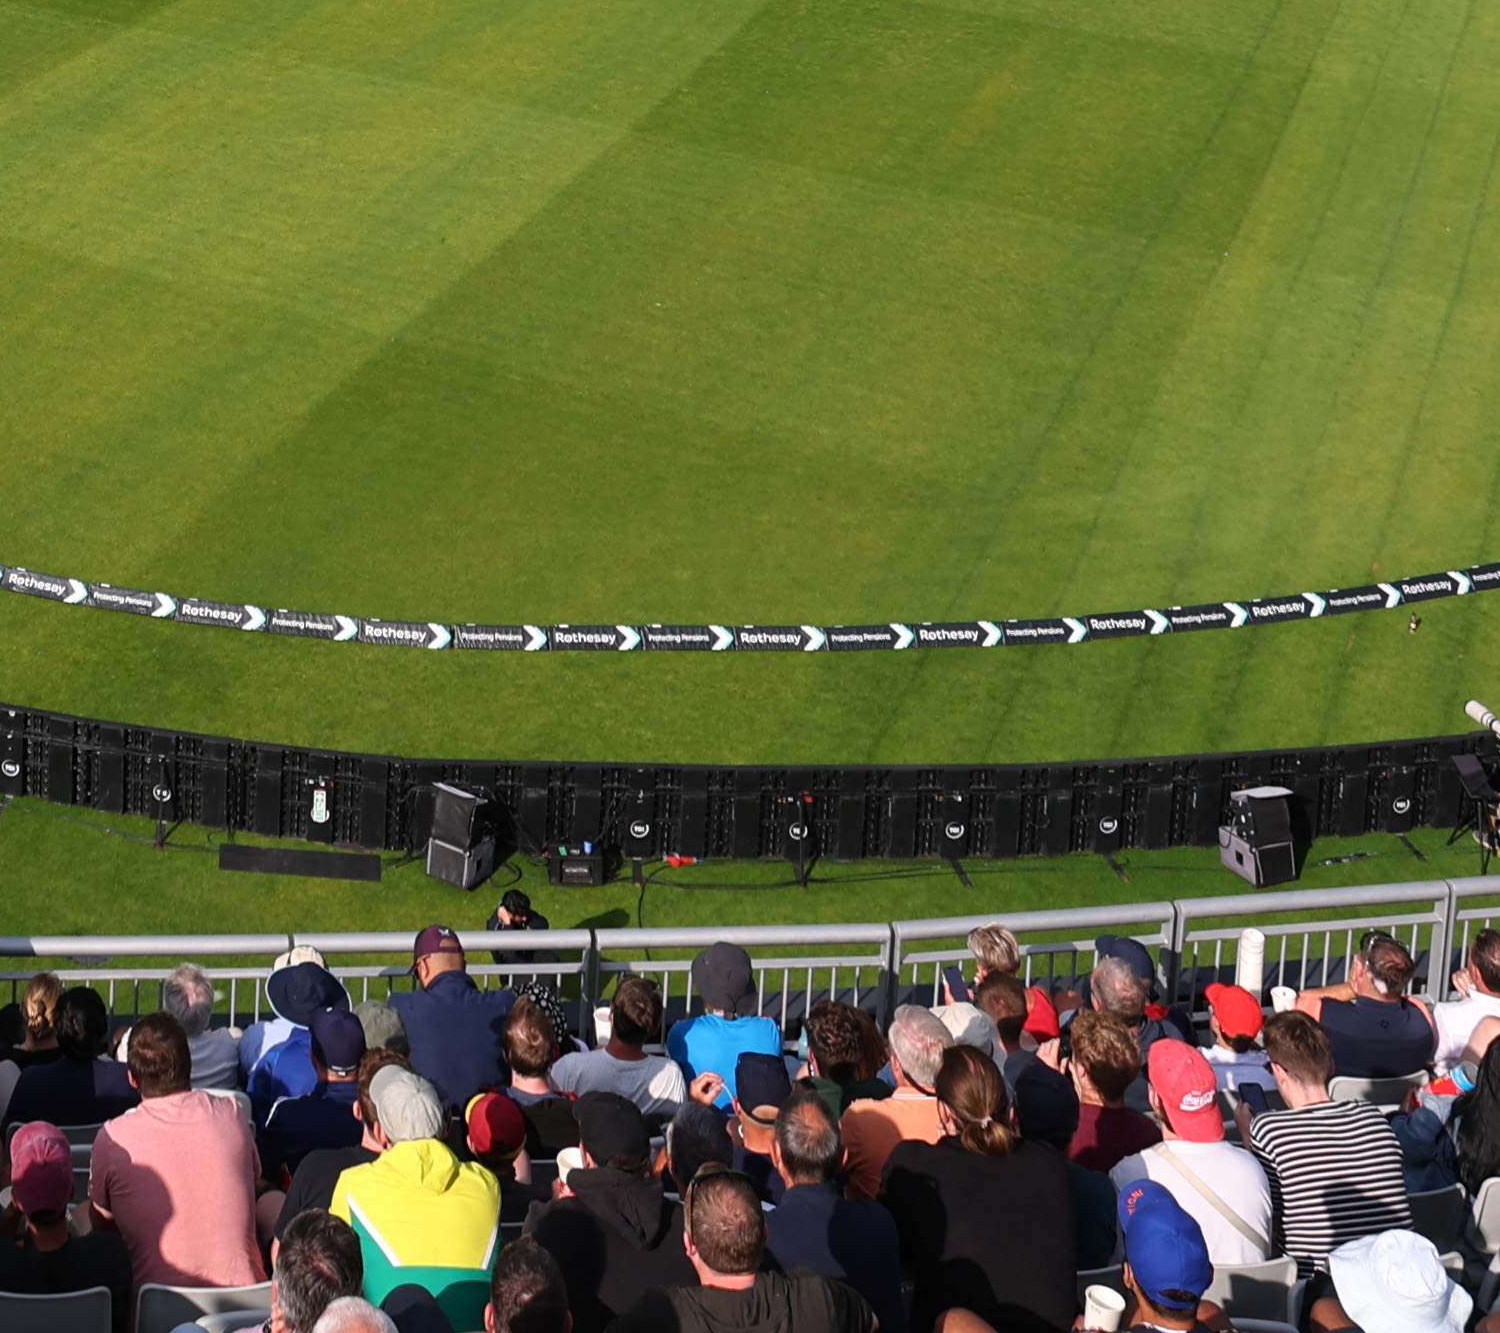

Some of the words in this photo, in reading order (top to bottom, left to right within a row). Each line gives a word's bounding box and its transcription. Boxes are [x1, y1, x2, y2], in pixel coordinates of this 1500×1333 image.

[8, 573, 66, 596] Rothesay
[1402, 579, 1452, 596] Rothesay
[182, 603, 243, 623] Rothesay
[272, 617, 304, 631] Protecting
[305, 620, 334, 631] Pensions
[365, 624, 427, 643] Rothesay
[555, 631, 616, 646] Rothesay
[648, 633, 681, 644] Protecting
[681, 632, 709, 643] Pensions
[740, 631, 801, 646] Rothesay
[920, 628, 979, 643] Rothesay
